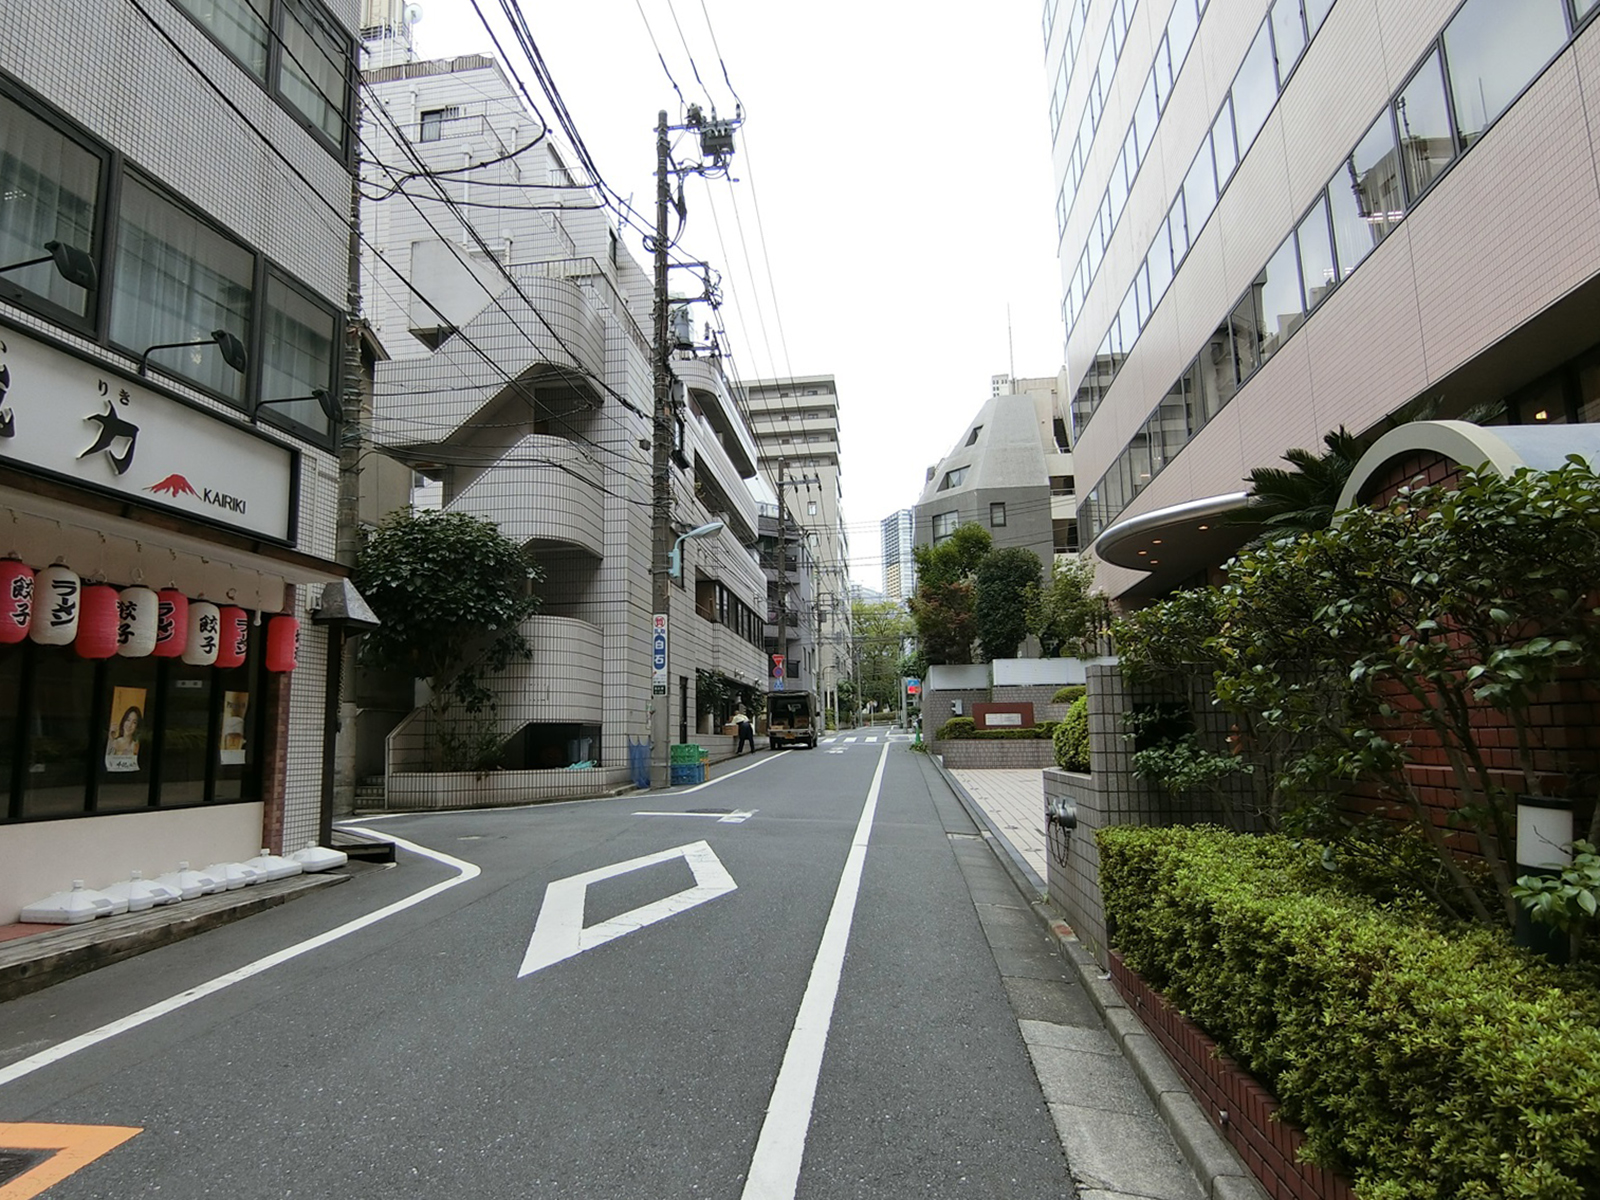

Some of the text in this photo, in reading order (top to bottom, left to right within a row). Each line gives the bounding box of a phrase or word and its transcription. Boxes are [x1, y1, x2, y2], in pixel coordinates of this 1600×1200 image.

[98, 379, 131, 406] りき
[76, 400, 139, 476] 力
[203, 487, 246, 515] KAIRIKI
[11, 576, 35, 627] 餃子
[51, 579, 77, 627] ラーメン
[199, 614, 218, 655] 餃子
[235, 618, 249, 656] ラーメン
[655, 640, 664, 664] 白石
